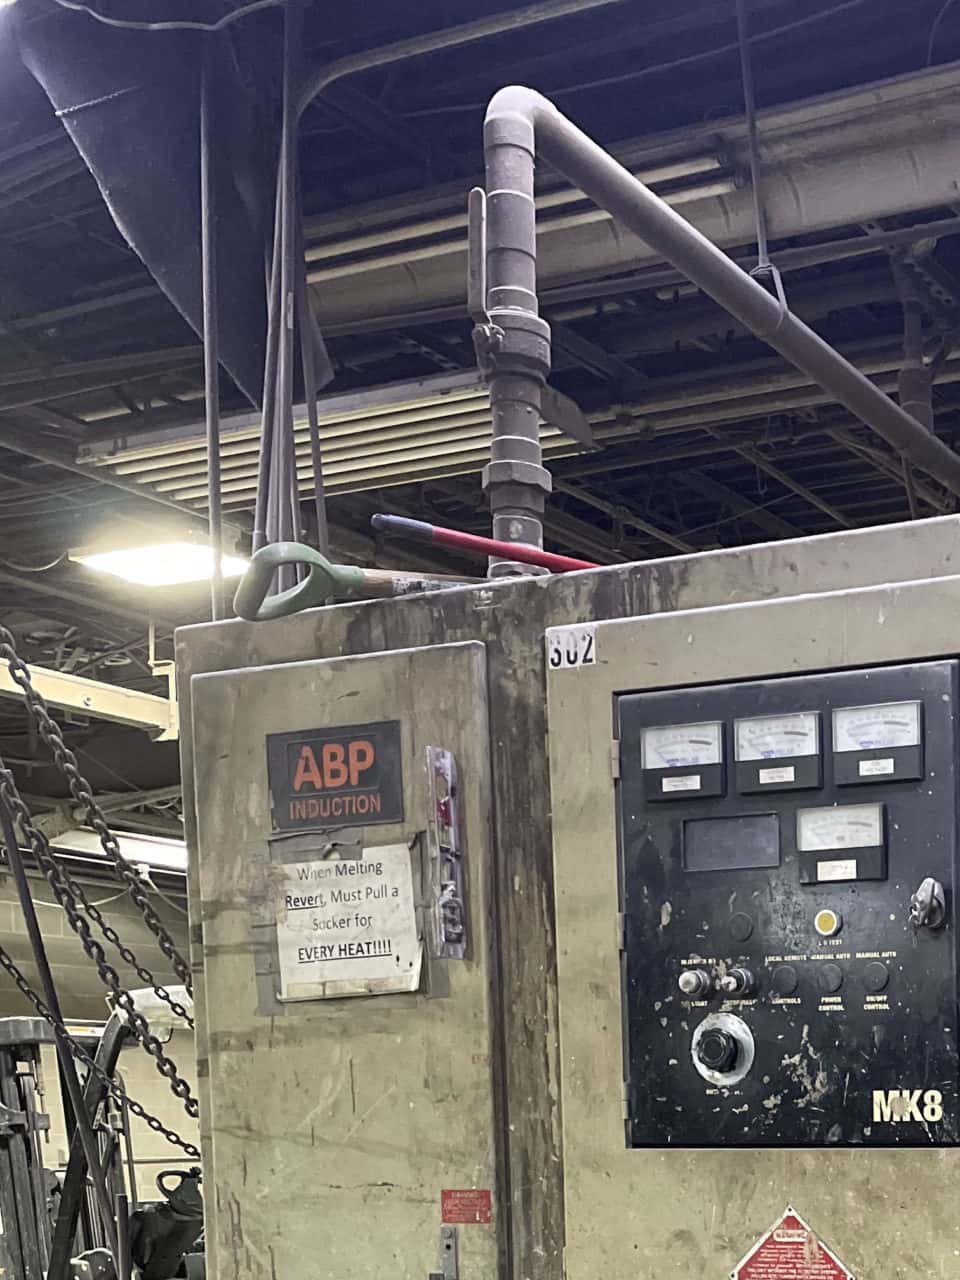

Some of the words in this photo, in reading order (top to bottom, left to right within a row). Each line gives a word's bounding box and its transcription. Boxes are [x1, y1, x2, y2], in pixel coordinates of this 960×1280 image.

[293, 740, 375, 792] ABP
[289, 794, 381, 820] INDUCTION
[297, 867, 332, 881] When
[335, 862, 384, 877] Melting
[330, 889, 361, 903] Must
[365, 884, 388, 899] Pull
[391, 887, 399, 897] a
[355, 913, 373, 928] for
[298, 945, 335, 961] EVERY
[338, 939, 392, 957] HEAT!!!!
[872, 1089, 944, 1122] MK8
